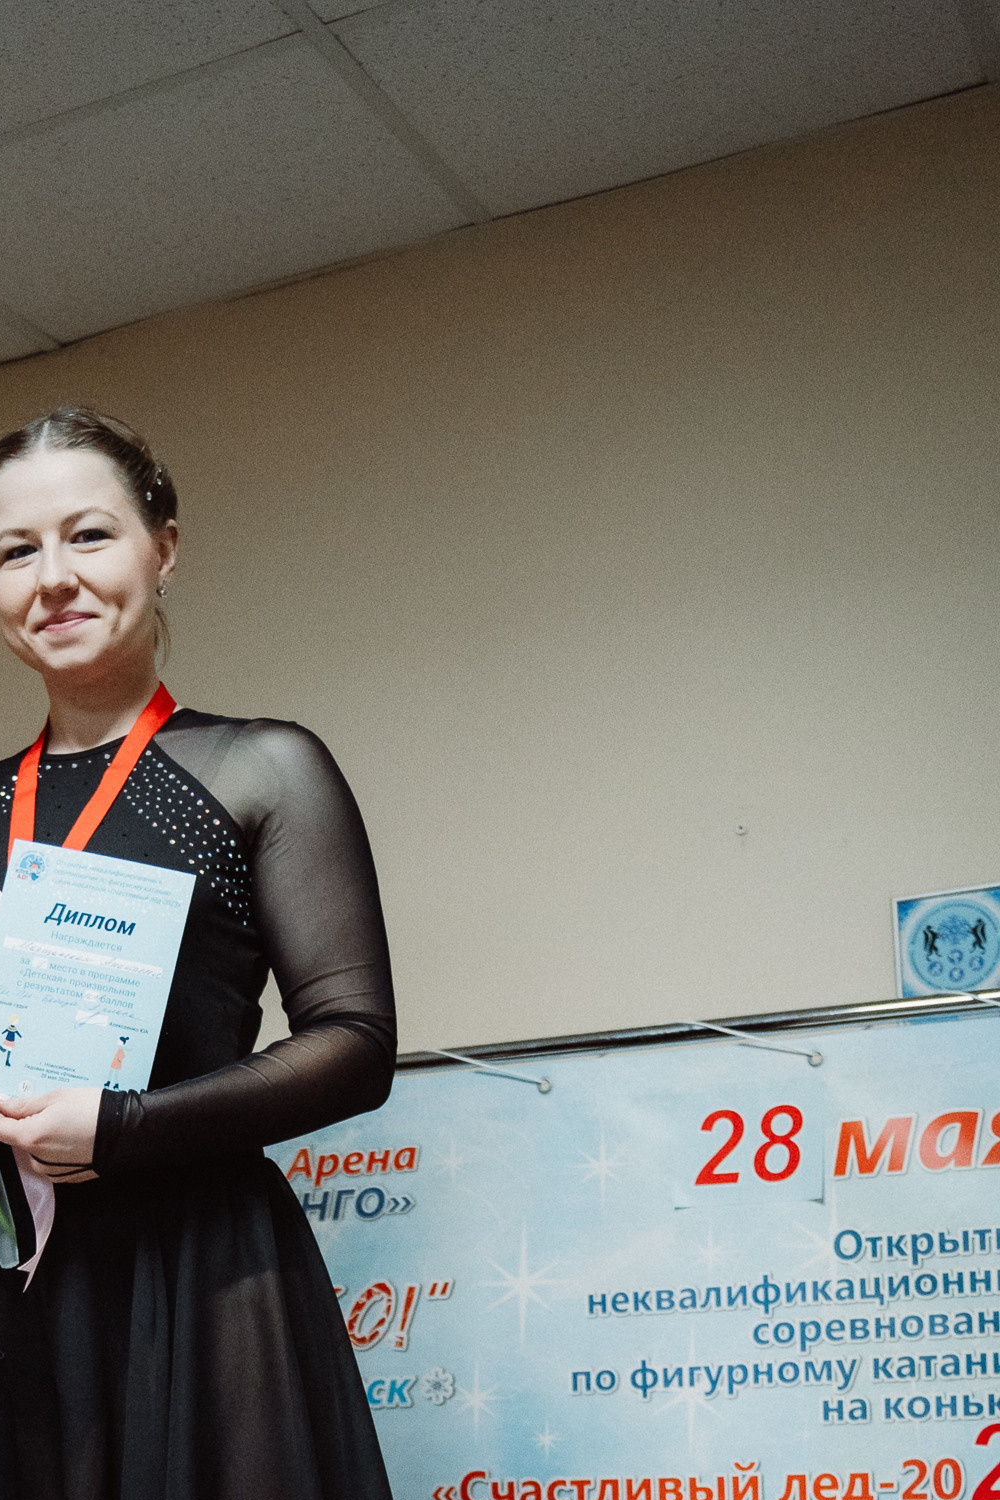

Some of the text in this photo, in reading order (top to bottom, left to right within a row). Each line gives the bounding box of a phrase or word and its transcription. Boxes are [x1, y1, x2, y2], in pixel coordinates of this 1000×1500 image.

[44, 903, 136, 936] Диплом
[50, 930, 123, 952] Награждается
[22, 982, 83, 998] результатом
[48, 963, 77, 974] место
[87, 971, 141, 987] программе
[68, 979, 136, 997] произвольная
[695, 1104, 803, 1187] 28
[286, 1147, 416, 1187] Арена
[302, 1187, 412, 1222] НГО»
[834, 1228, 1000, 1265] Открыт
[588, 1270, 1000, 1315] неквалификационн
[572, 1370, 616, 1393] по
[630, 1358, 857, 1399] фигурному
[823, 1400, 867, 1422] на
